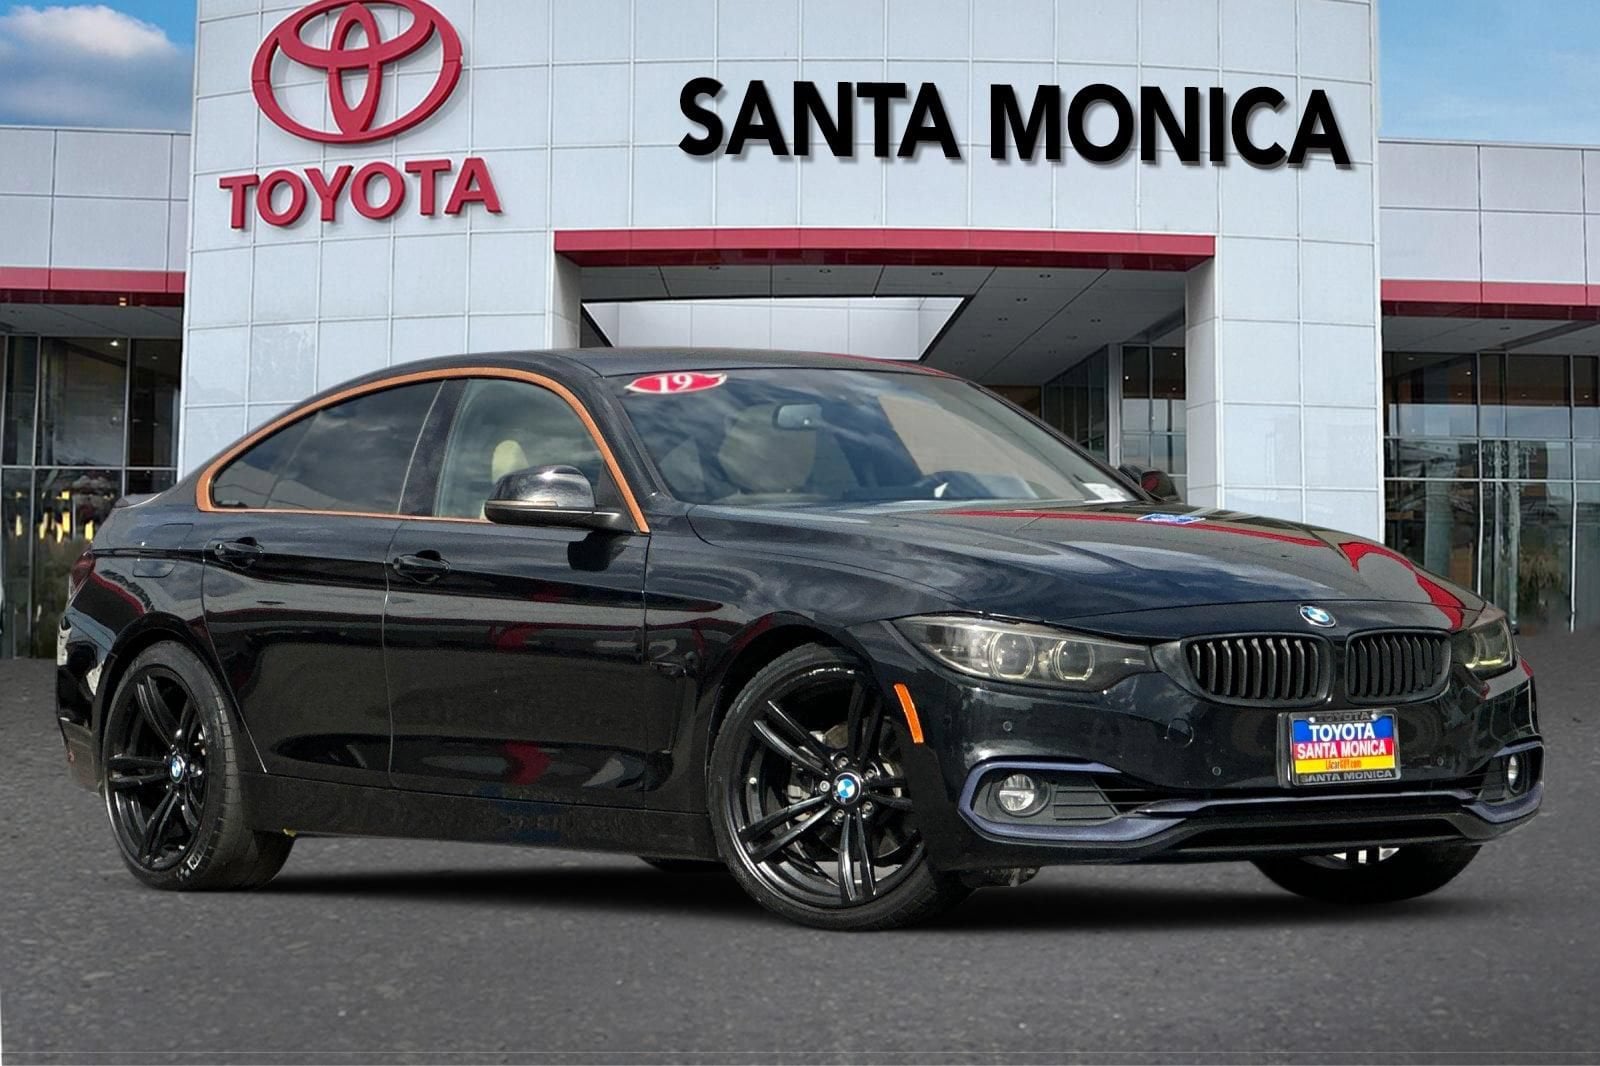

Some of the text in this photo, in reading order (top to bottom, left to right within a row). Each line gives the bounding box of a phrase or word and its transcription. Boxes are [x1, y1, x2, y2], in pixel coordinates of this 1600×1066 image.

[678, 77, 1352, 167] SANTA MONICA
[220, 157, 502, 229] TOYOTA
[657, 373, 693, 394] 19
[1317, 712, 1370, 721] TOYOTA
[1309, 723, 1375, 742] TOYOTA
[1297, 740, 1386, 759] SANTA MONICA
[1302, 770, 1393, 783] SANTA MONICA
